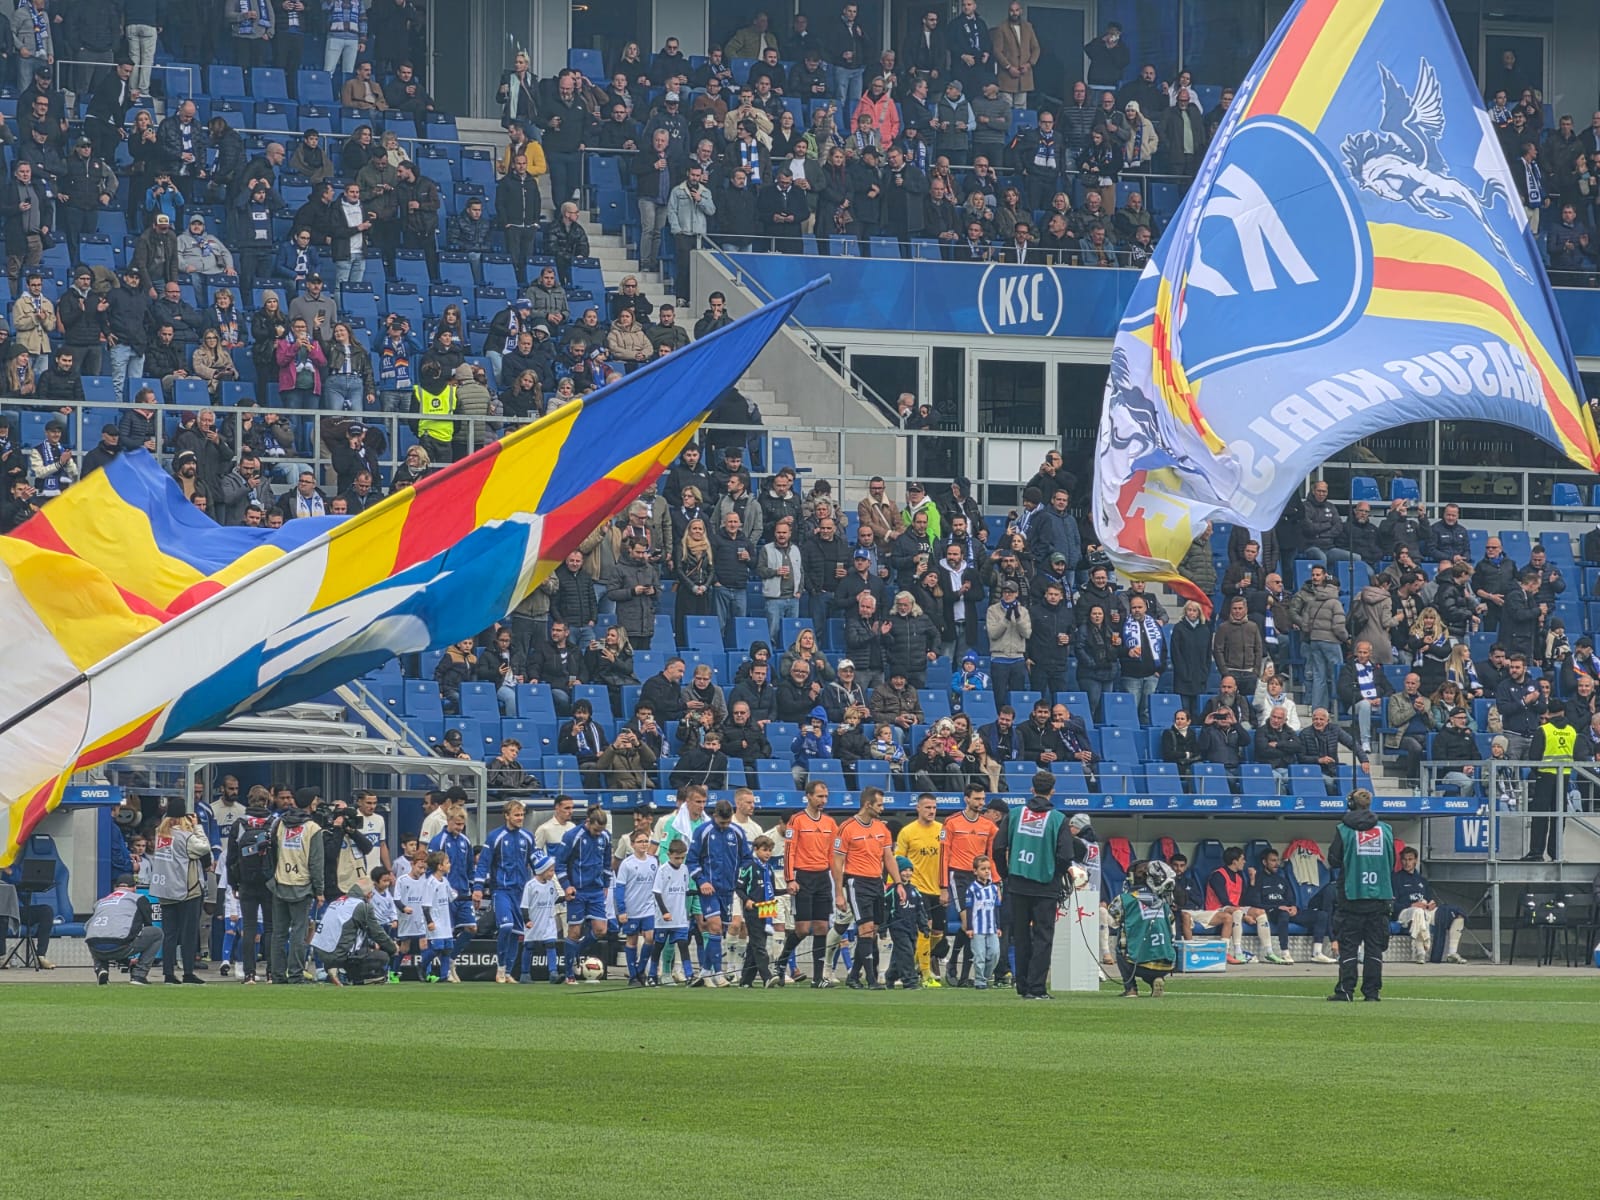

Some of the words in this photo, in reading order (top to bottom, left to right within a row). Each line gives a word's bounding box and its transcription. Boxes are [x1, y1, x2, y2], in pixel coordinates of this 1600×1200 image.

[999, 272, 1044, 326] KSC
[81, 789, 109, 798] SWEG
[935, 796, 961, 804] SWEG
[1064, 798, 1089, 806] SWEG
[1128, 798, 1153, 806] SWEG
[1193, 798, 1218, 806] SWEG
[1256, 799, 1281, 807] SWEG
[1319, 799, 1344, 808] SWEG
[1382, 800, 1407, 808] SWEG
[1444, 801, 1469, 809] SWEG
[1018, 849, 1035, 864] 10
[285, 862, 299, 874] 04
[152, 873, 166, 885] 08
[1362, 871, 1378, 884] 20
[92, 916, 109, 927] 23
